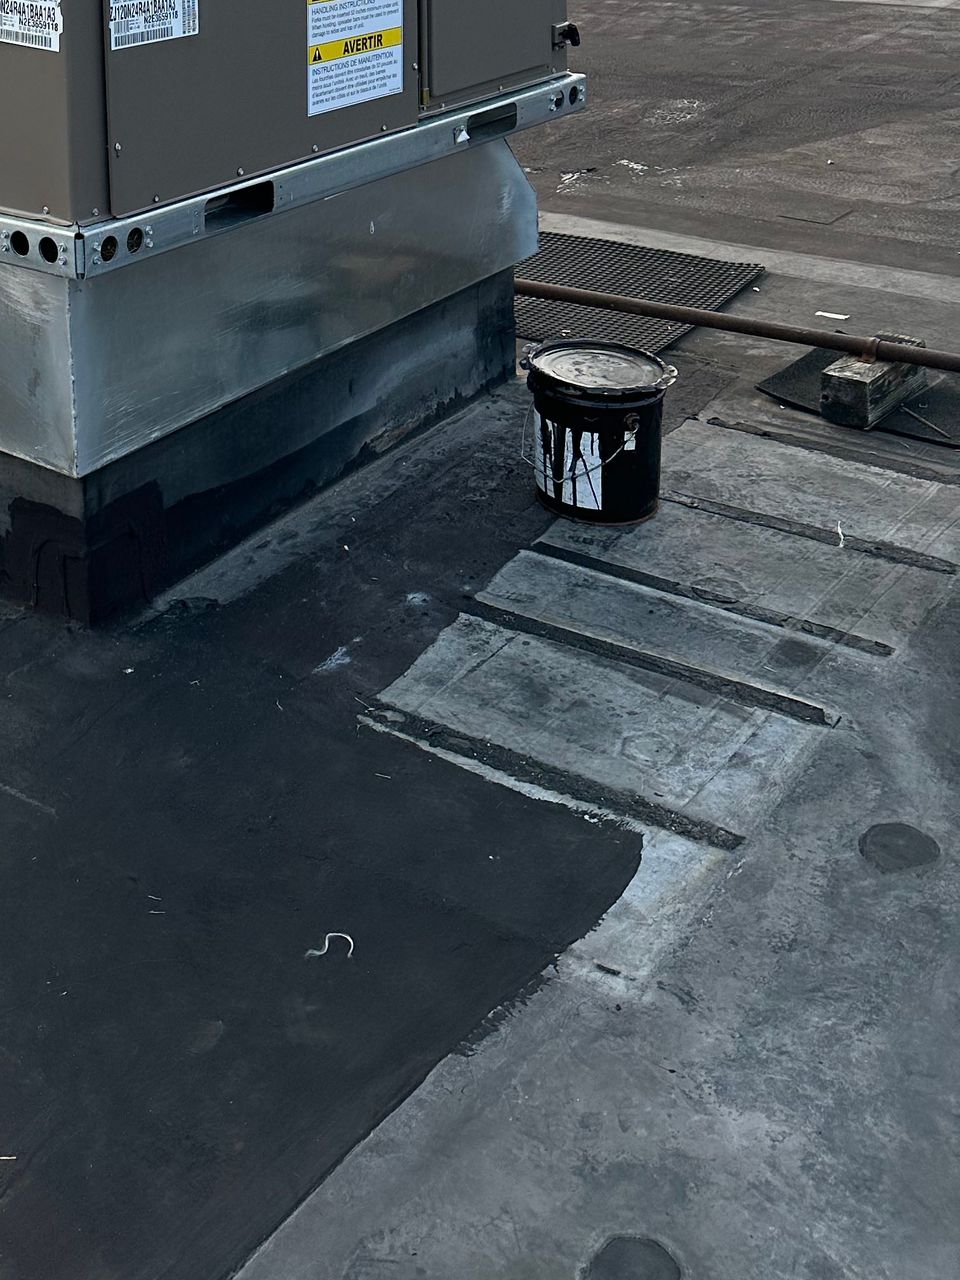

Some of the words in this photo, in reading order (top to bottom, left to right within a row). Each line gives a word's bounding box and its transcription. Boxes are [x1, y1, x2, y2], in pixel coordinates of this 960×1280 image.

[312, 4, 338, 16] HANDLING
[343, 34, 383, 55] AVERTIR
[312, 61, 350, 76] INSTRUCTIONS
[350, 58, 358, 68] DE
[358, 52, 394, 66] MANUTENTION
